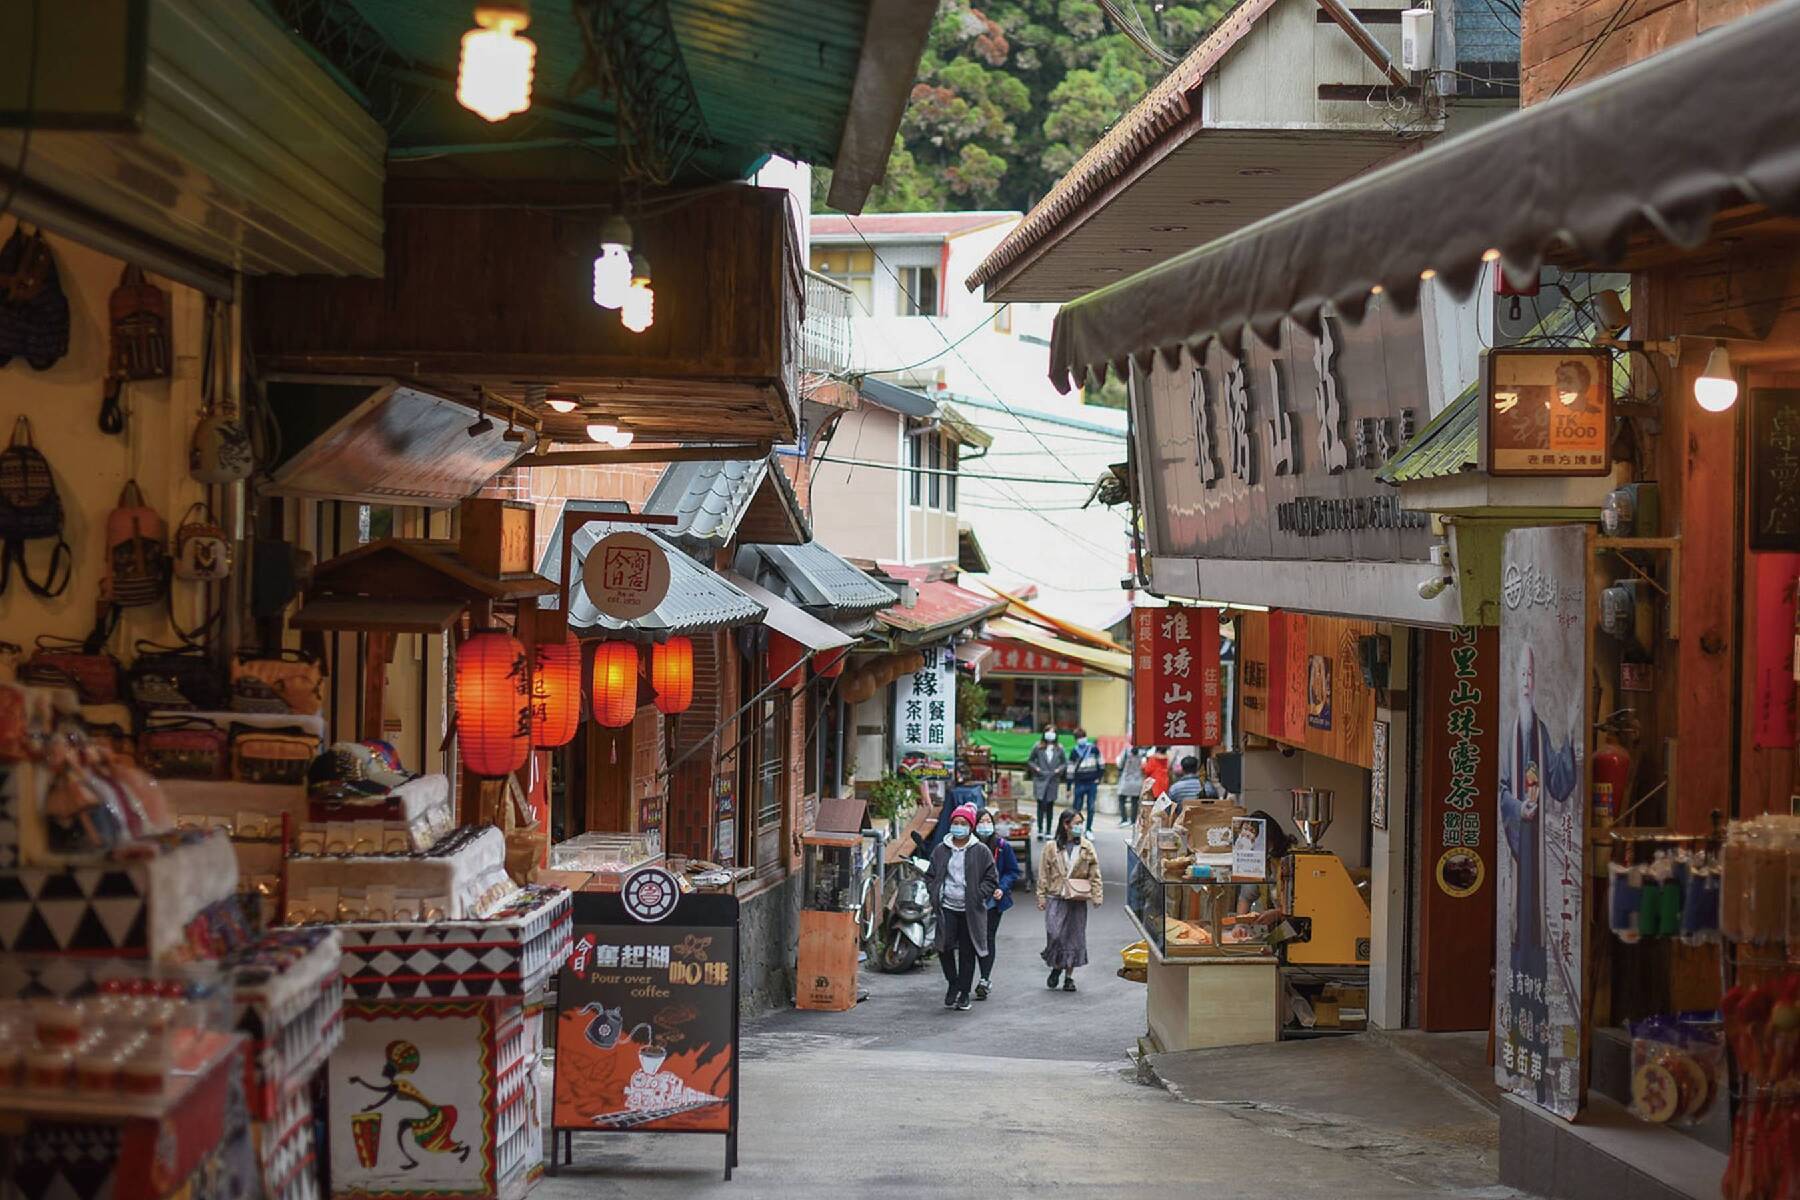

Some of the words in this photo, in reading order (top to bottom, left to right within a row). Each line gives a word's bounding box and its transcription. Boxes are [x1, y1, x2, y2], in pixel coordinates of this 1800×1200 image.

[1555, 427, 1598, 439] FOOD
[607, 550, 630, 586] 今日
[1160, 611, 1193, 739] 雅琇山莊
[905, 699, 922, 744] 茶葉
[928, 700, 945, 744] 餐館
[1445, 625, 1484, 810] 阿里山珠露茶
[574, 938, 594, 972] 今日
[597, 944, 670, 968] 奮起湖
[591, 972, 620, 984] Pour
[624, 974, 653, 984] over
[630, 985, 670, 998] coffee
